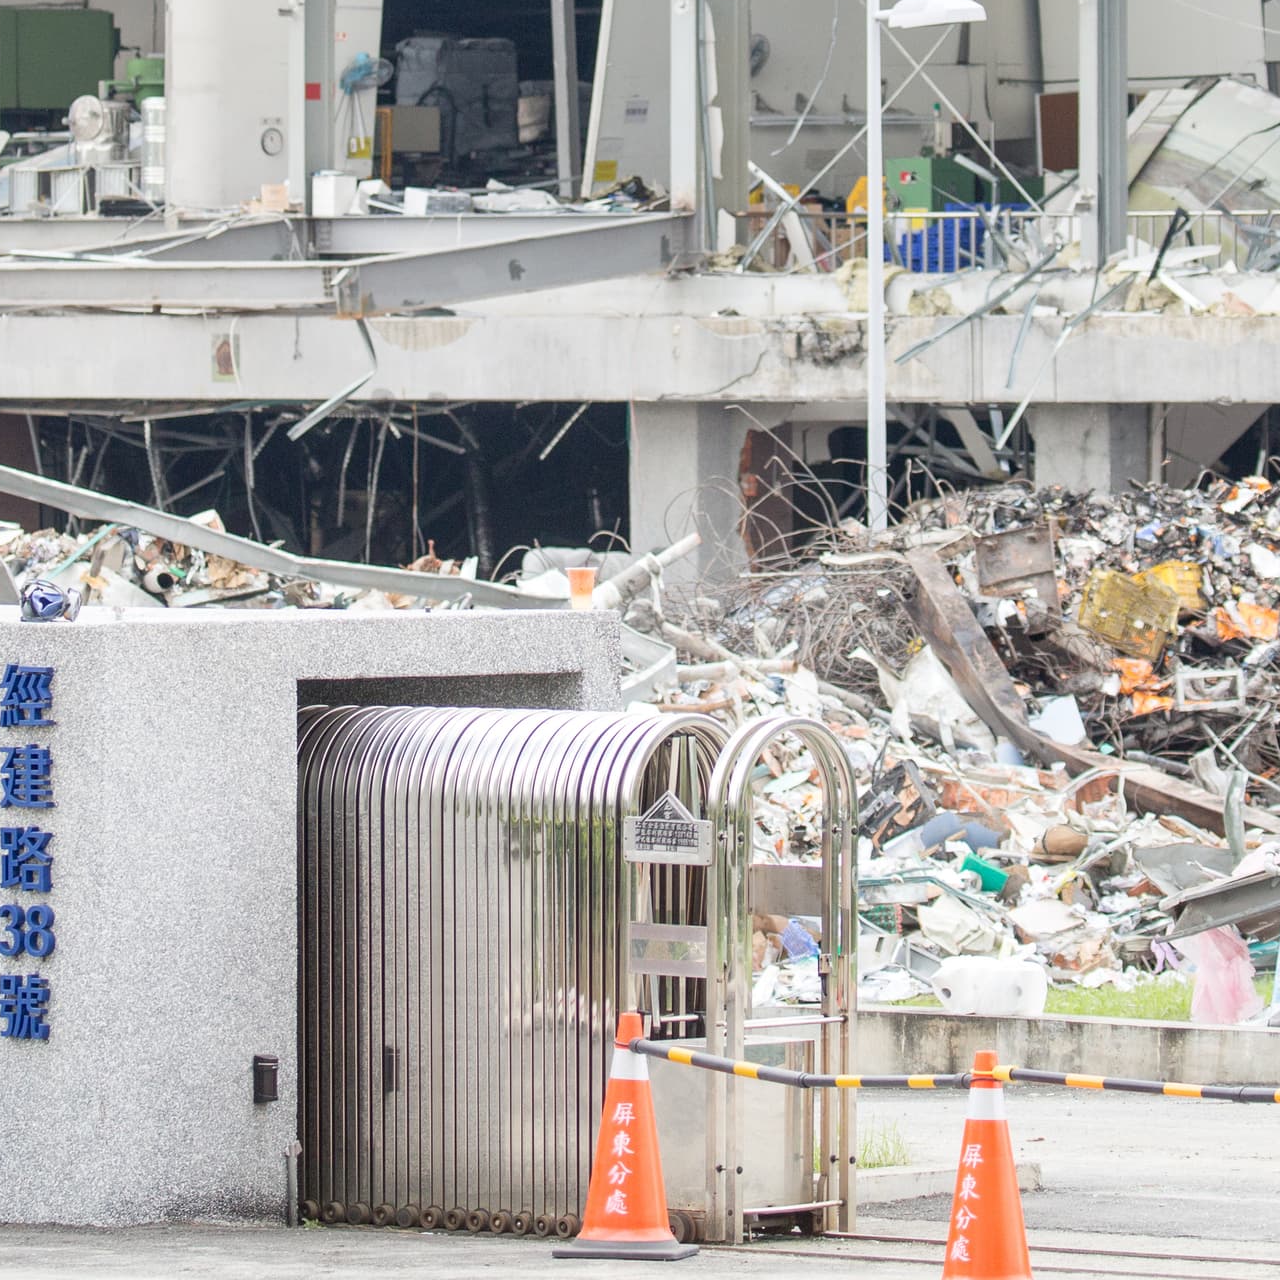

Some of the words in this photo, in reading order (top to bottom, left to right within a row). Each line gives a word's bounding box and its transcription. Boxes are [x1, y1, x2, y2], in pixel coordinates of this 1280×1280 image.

[605, 1103, 637, 1215] 屏東分處
[950, 1143, 984, 1262] 屏東分處
